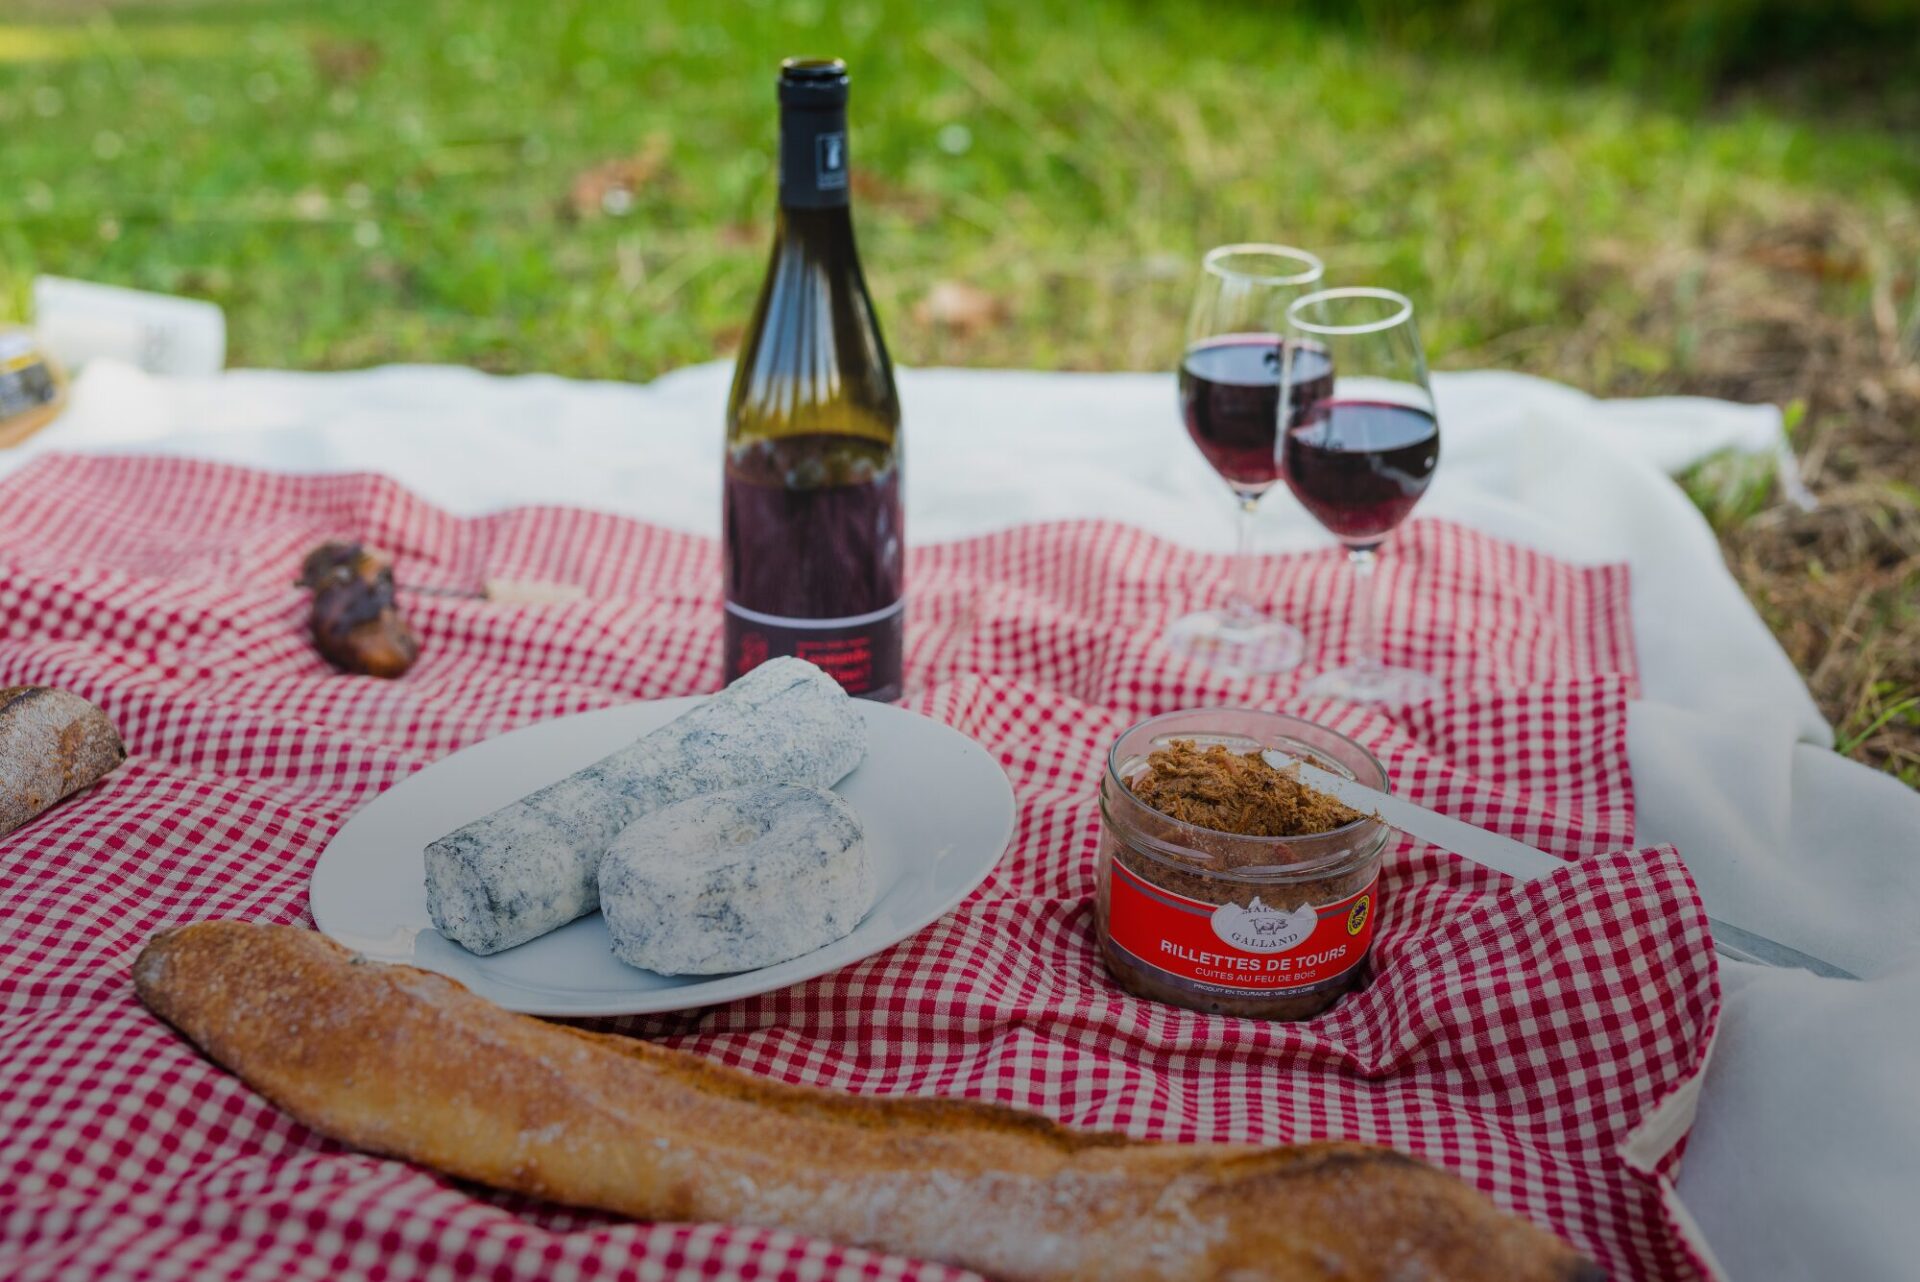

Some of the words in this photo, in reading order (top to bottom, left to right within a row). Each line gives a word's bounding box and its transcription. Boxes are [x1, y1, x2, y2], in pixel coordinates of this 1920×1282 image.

[1231, 932, 1298, 948] GALLAND
[1160, 939, 1262, 971] RILLETTES
[1266, 958, 1291, 971] DE
[1295, 944, 1347, 969] TOURS
[1195, 967, 1234, 981] CUITES
[1236, 974, 1252, 982] AU
[1254, 975, 1276, 983] FEU
[1278, 974, 1292, 982] DE
[1293, 970, 1316, 981] BOIS
[1193, 983, 1224, 993] PRODUIT
[1297, 985, 1315, 994] LOIRE
